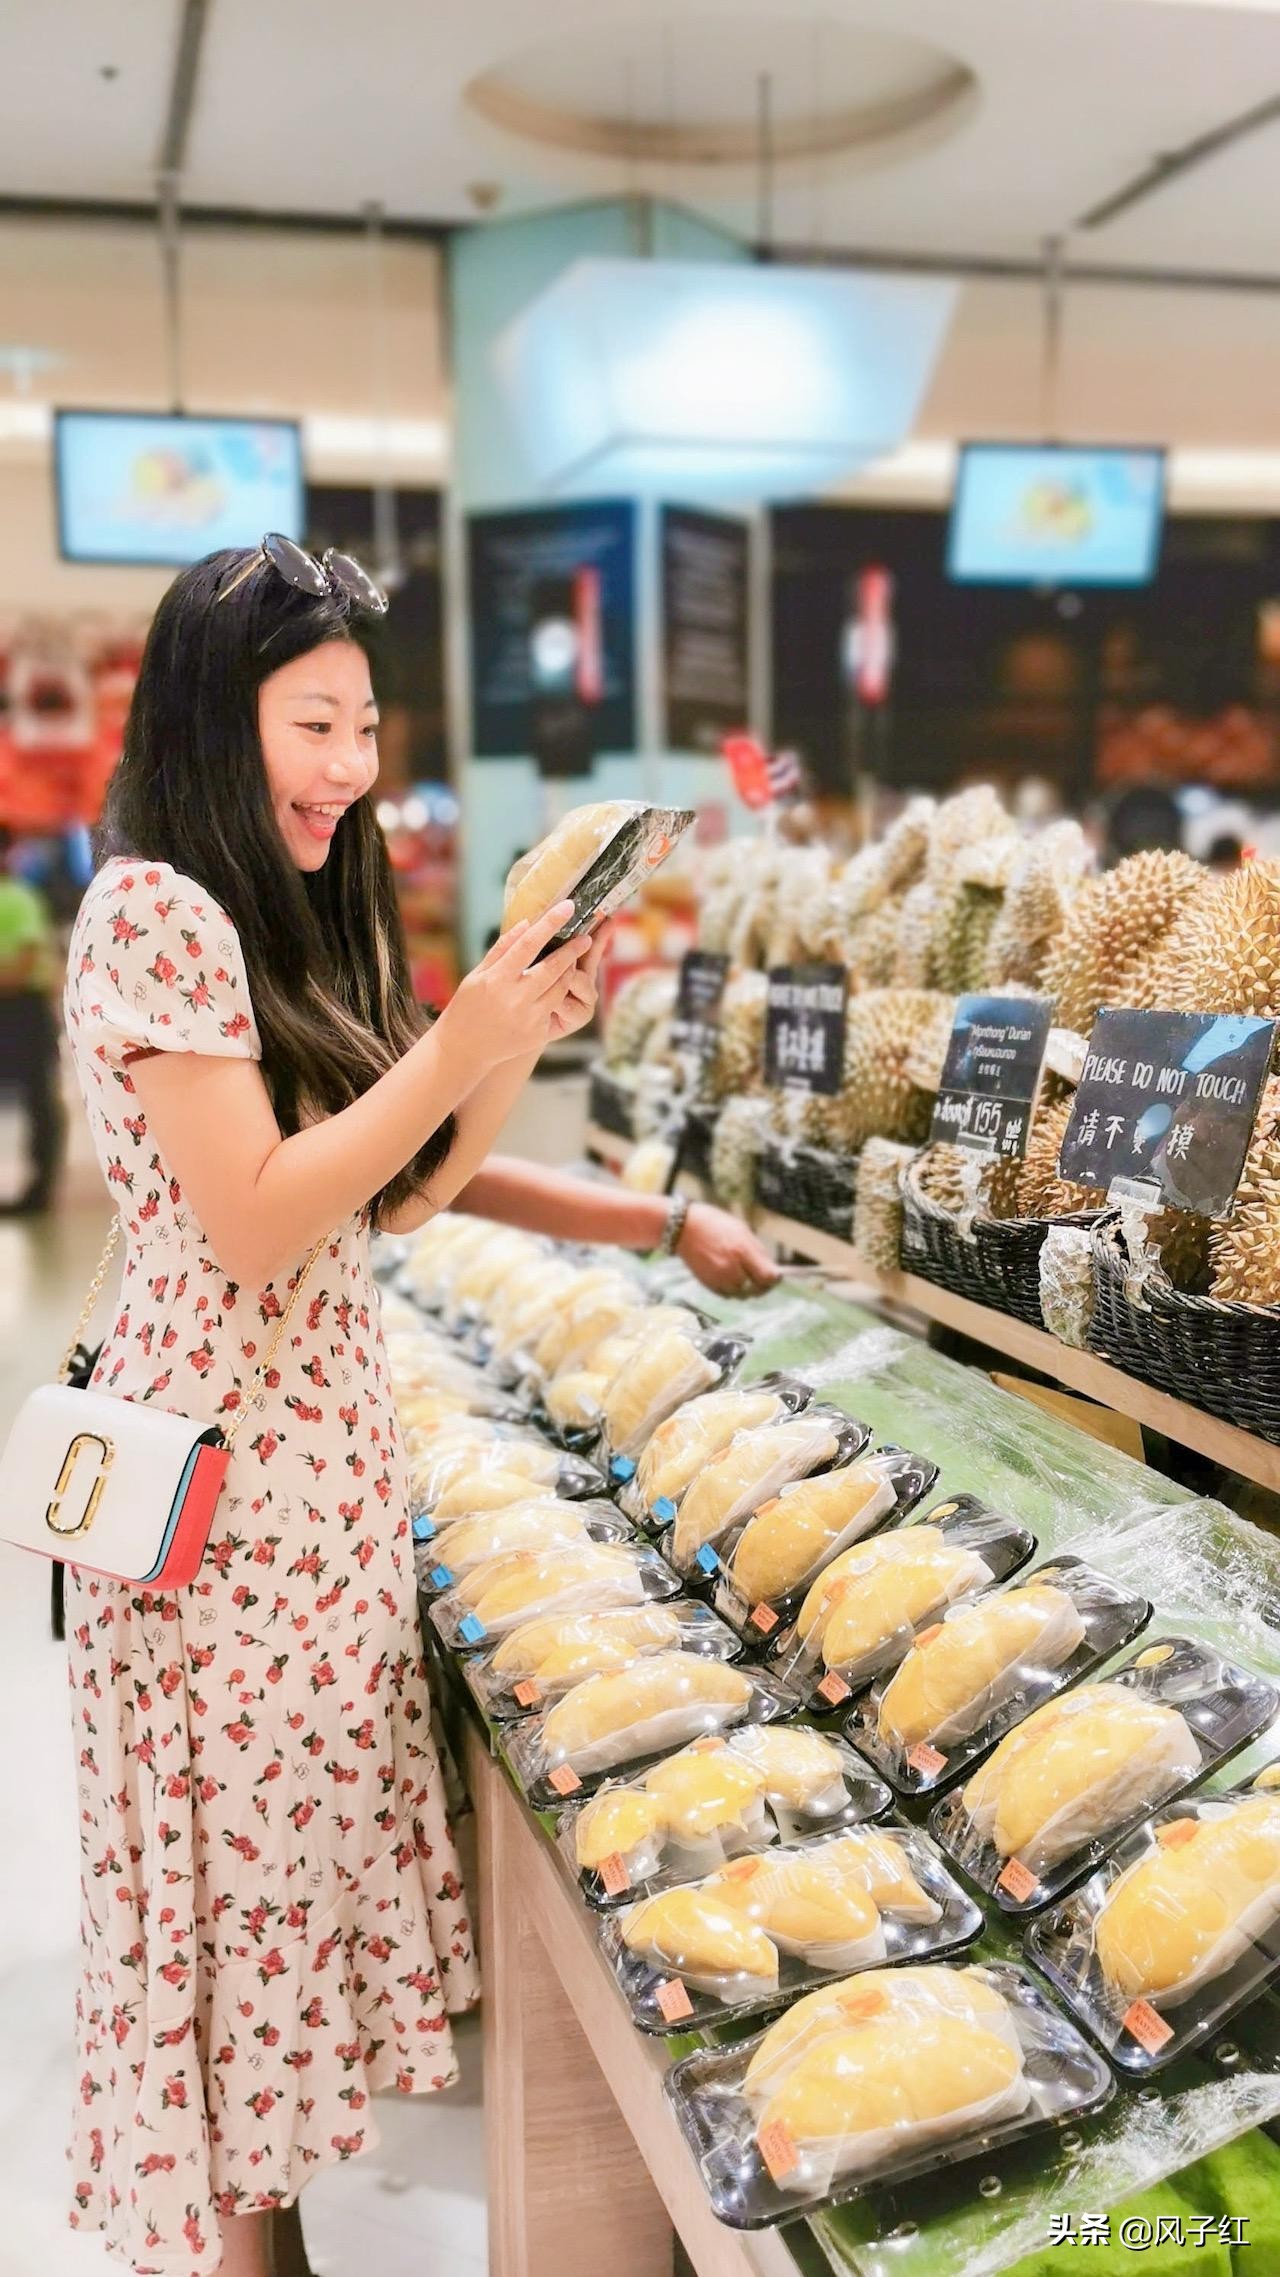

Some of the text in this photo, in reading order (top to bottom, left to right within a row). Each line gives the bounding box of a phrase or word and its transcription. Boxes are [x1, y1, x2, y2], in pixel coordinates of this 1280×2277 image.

[1008, 1026, 1032, 1041] Durian
[1082, 1055, 1248, 1105] PLEASE DO NOT TOUCH
[974, 1101, 1003, 1137] 155
